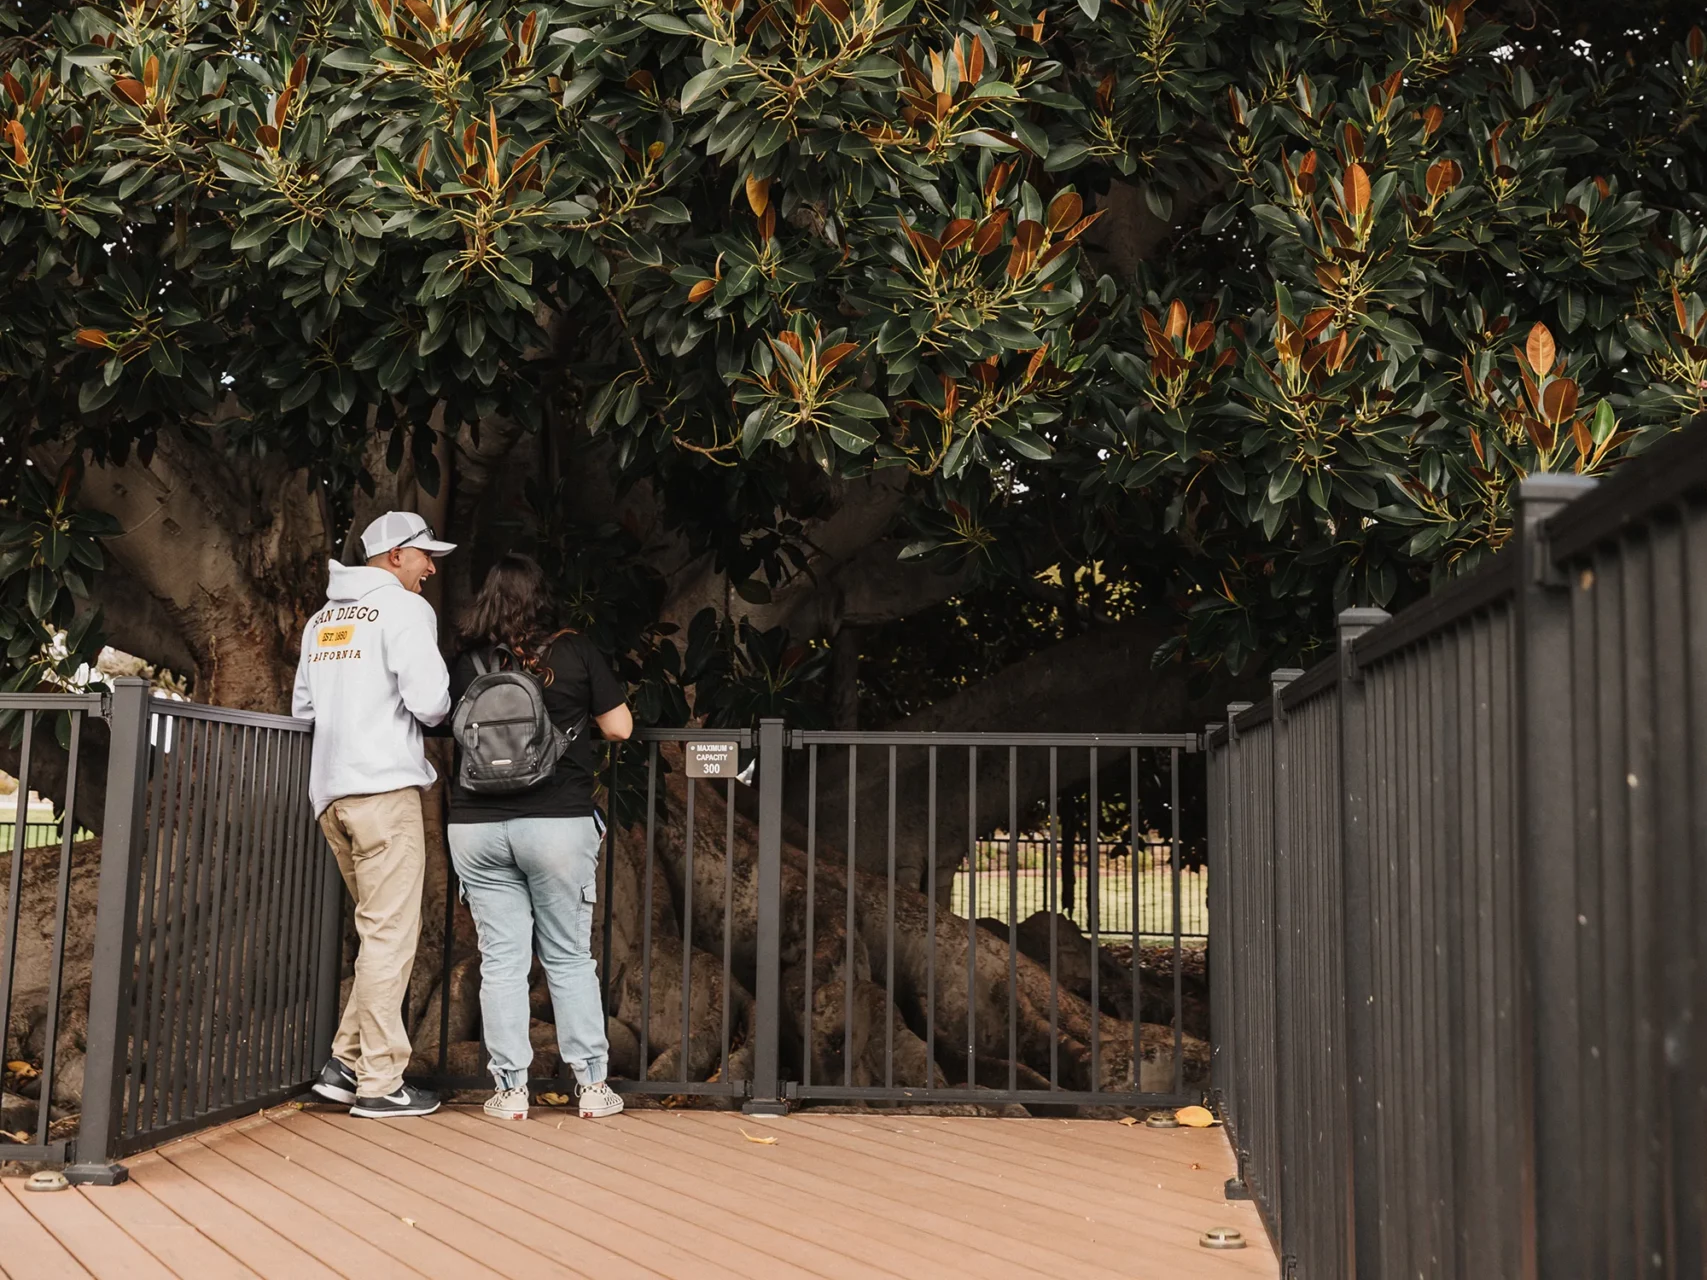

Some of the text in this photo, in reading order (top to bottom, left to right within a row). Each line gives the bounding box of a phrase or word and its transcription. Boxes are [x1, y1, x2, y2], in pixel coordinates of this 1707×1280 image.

[336, 606, 379, 622] DIEGO
[696, 744, 728, 752] MAXIMUM
[696, 753, 728, 761] CAPACITY
[703, 763, 720, 774] 300
